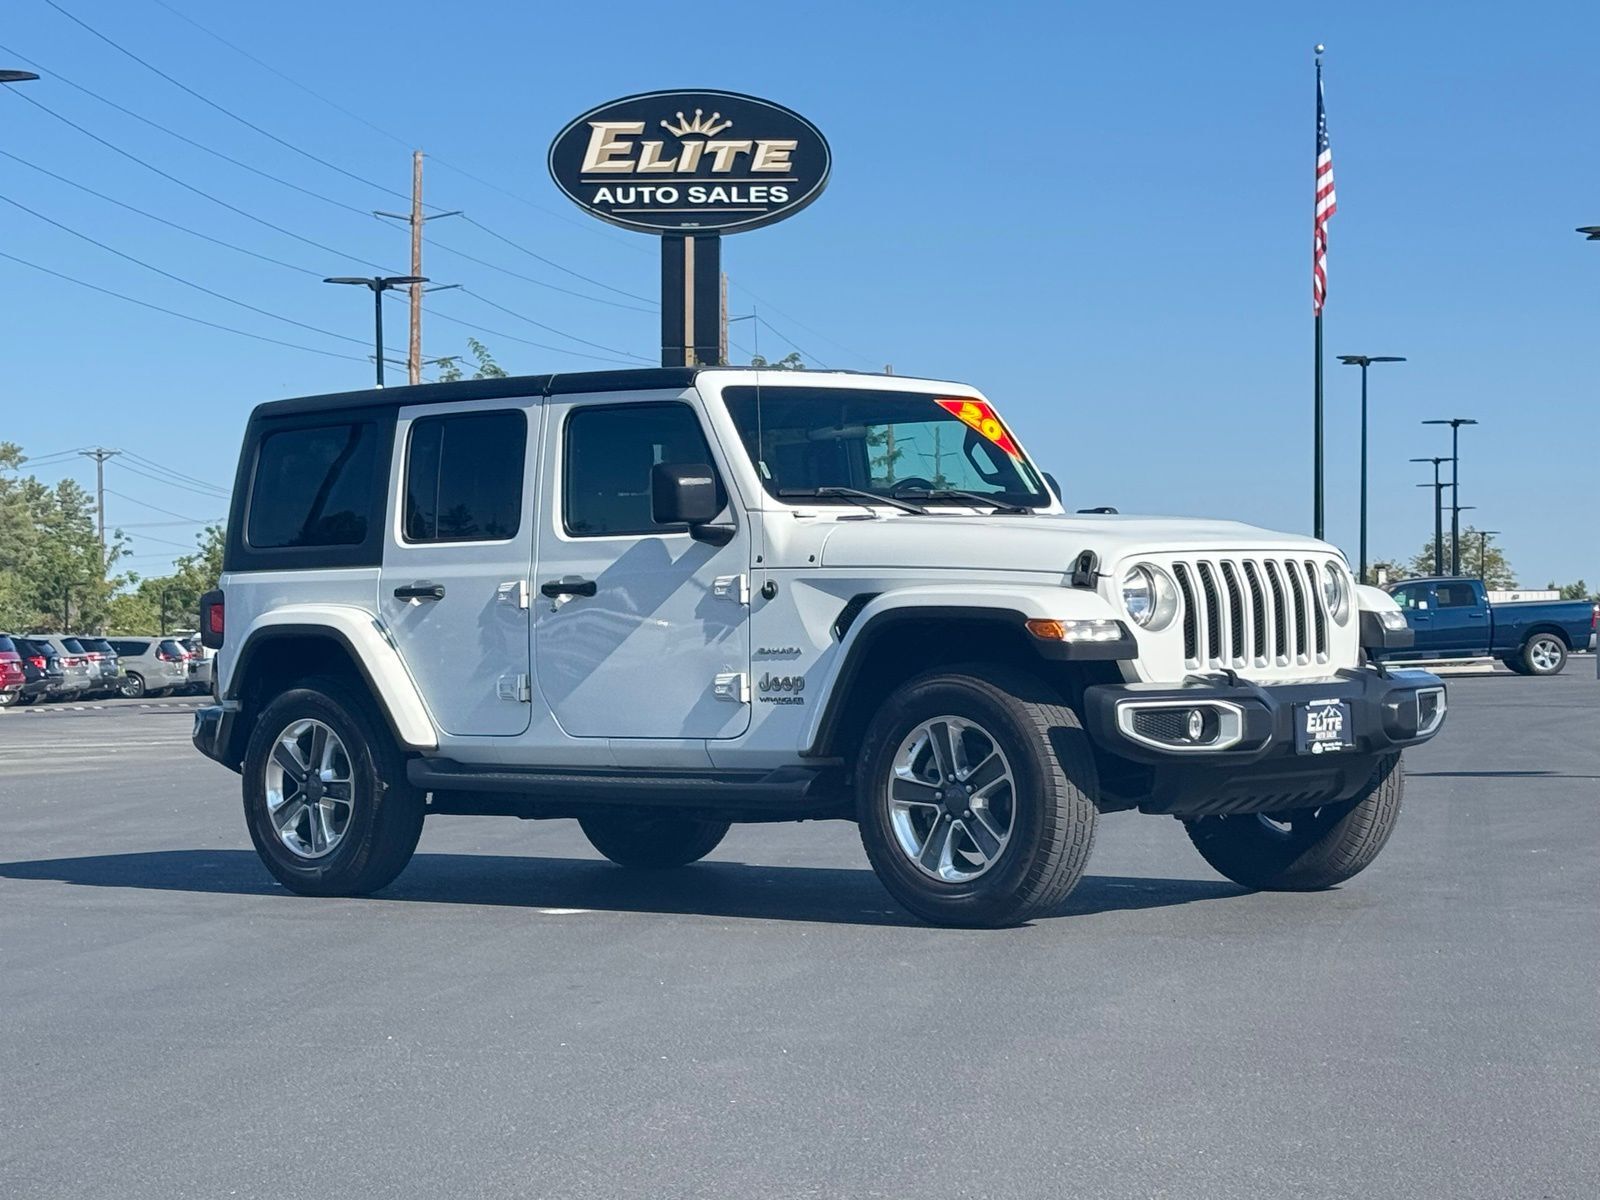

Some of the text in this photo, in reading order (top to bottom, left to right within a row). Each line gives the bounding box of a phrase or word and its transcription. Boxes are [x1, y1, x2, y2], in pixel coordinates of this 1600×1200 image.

[581, 122, 798, 173] ELITE
[593, 186, 789, 203] AUTO SALES
[959, 402, 1002, 441] 20
[759, 672, 805, 695] Jeep
[1307, 713, 1342, 733] ELITE
